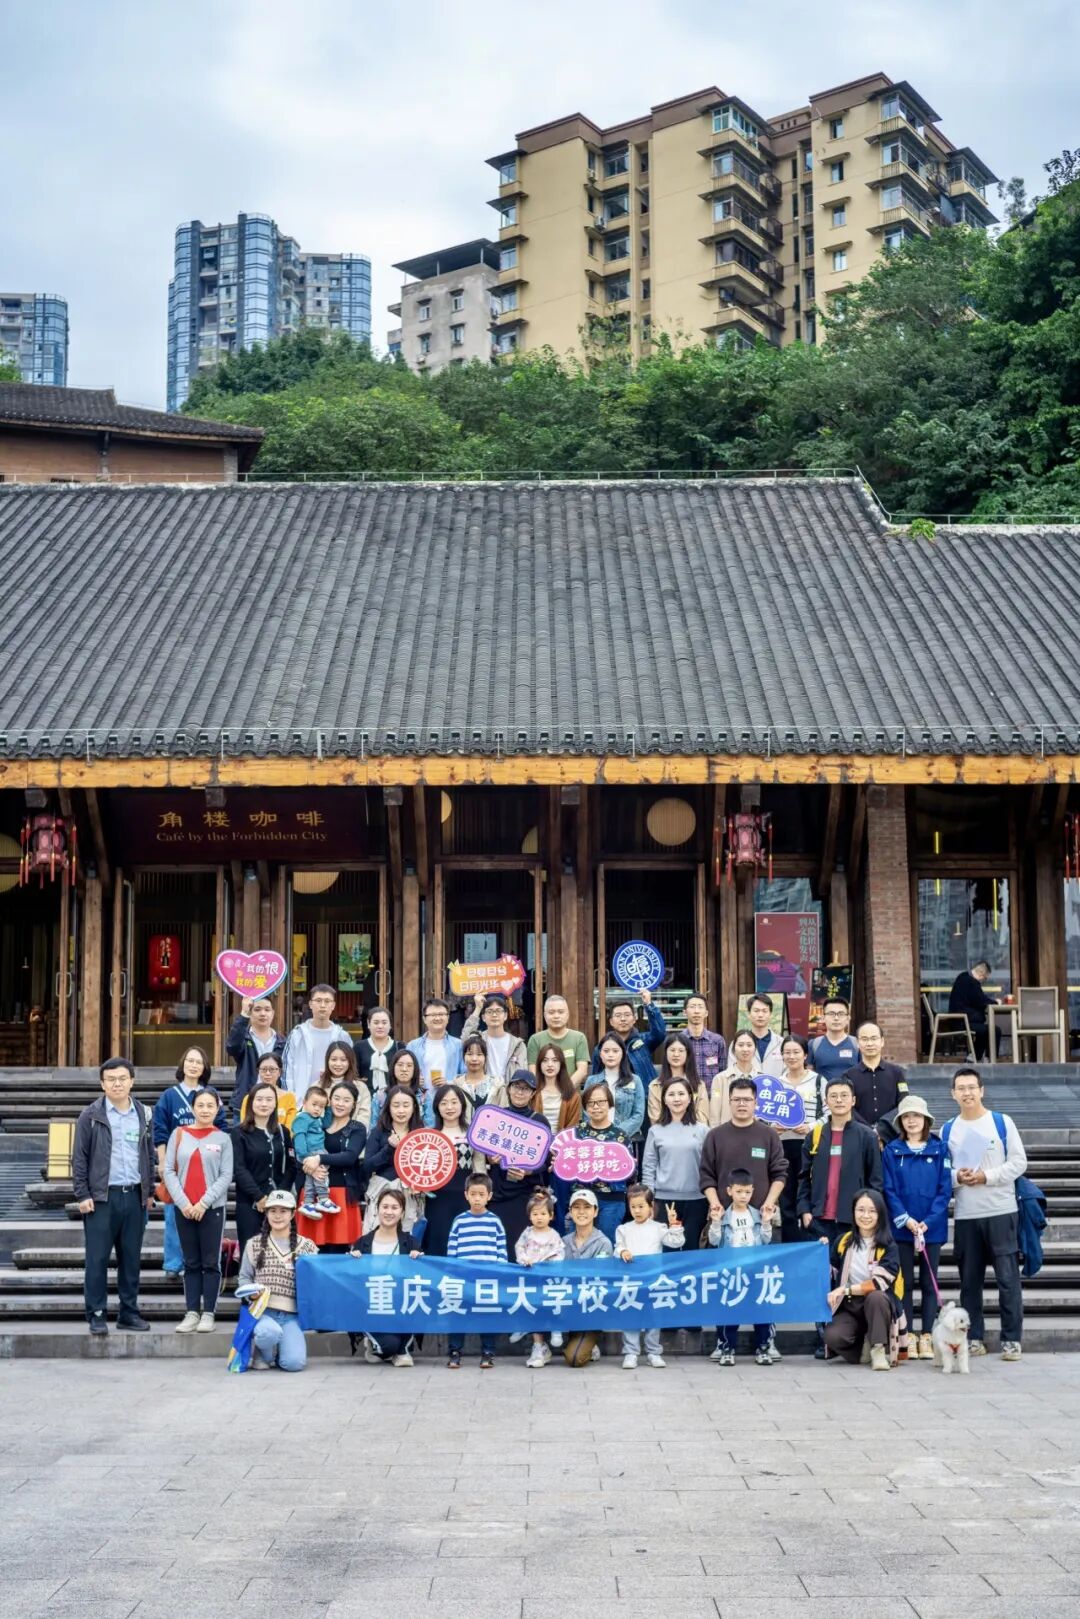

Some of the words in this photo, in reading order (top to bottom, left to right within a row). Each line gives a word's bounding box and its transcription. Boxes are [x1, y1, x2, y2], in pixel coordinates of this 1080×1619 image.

[158, 811, 325, 828] 角楼咖啡
[156, 832, 186, 842] Café
[188, 832, 203, 843] by
[207, 832, 228, 841] the
[232, 831, 298, 841] Forbidden
[301, 831, 328, 842] City
[622, 945, 660, 971] UNIVERSITY
[761, 1101, 790, 1118] 无用
[497, 1120, 529, 1140] 3108
[476, 1127, 537, 1160] 青春集结号
[419, 1134, 452, 1177] UNIVERSITY
[577, 1159, 620, 1174] 好好吃
[408, 1173, 438, 1186] 1905
[365, 1265, 786, 1316] 重庆复旦大学校友会3F沙龙
